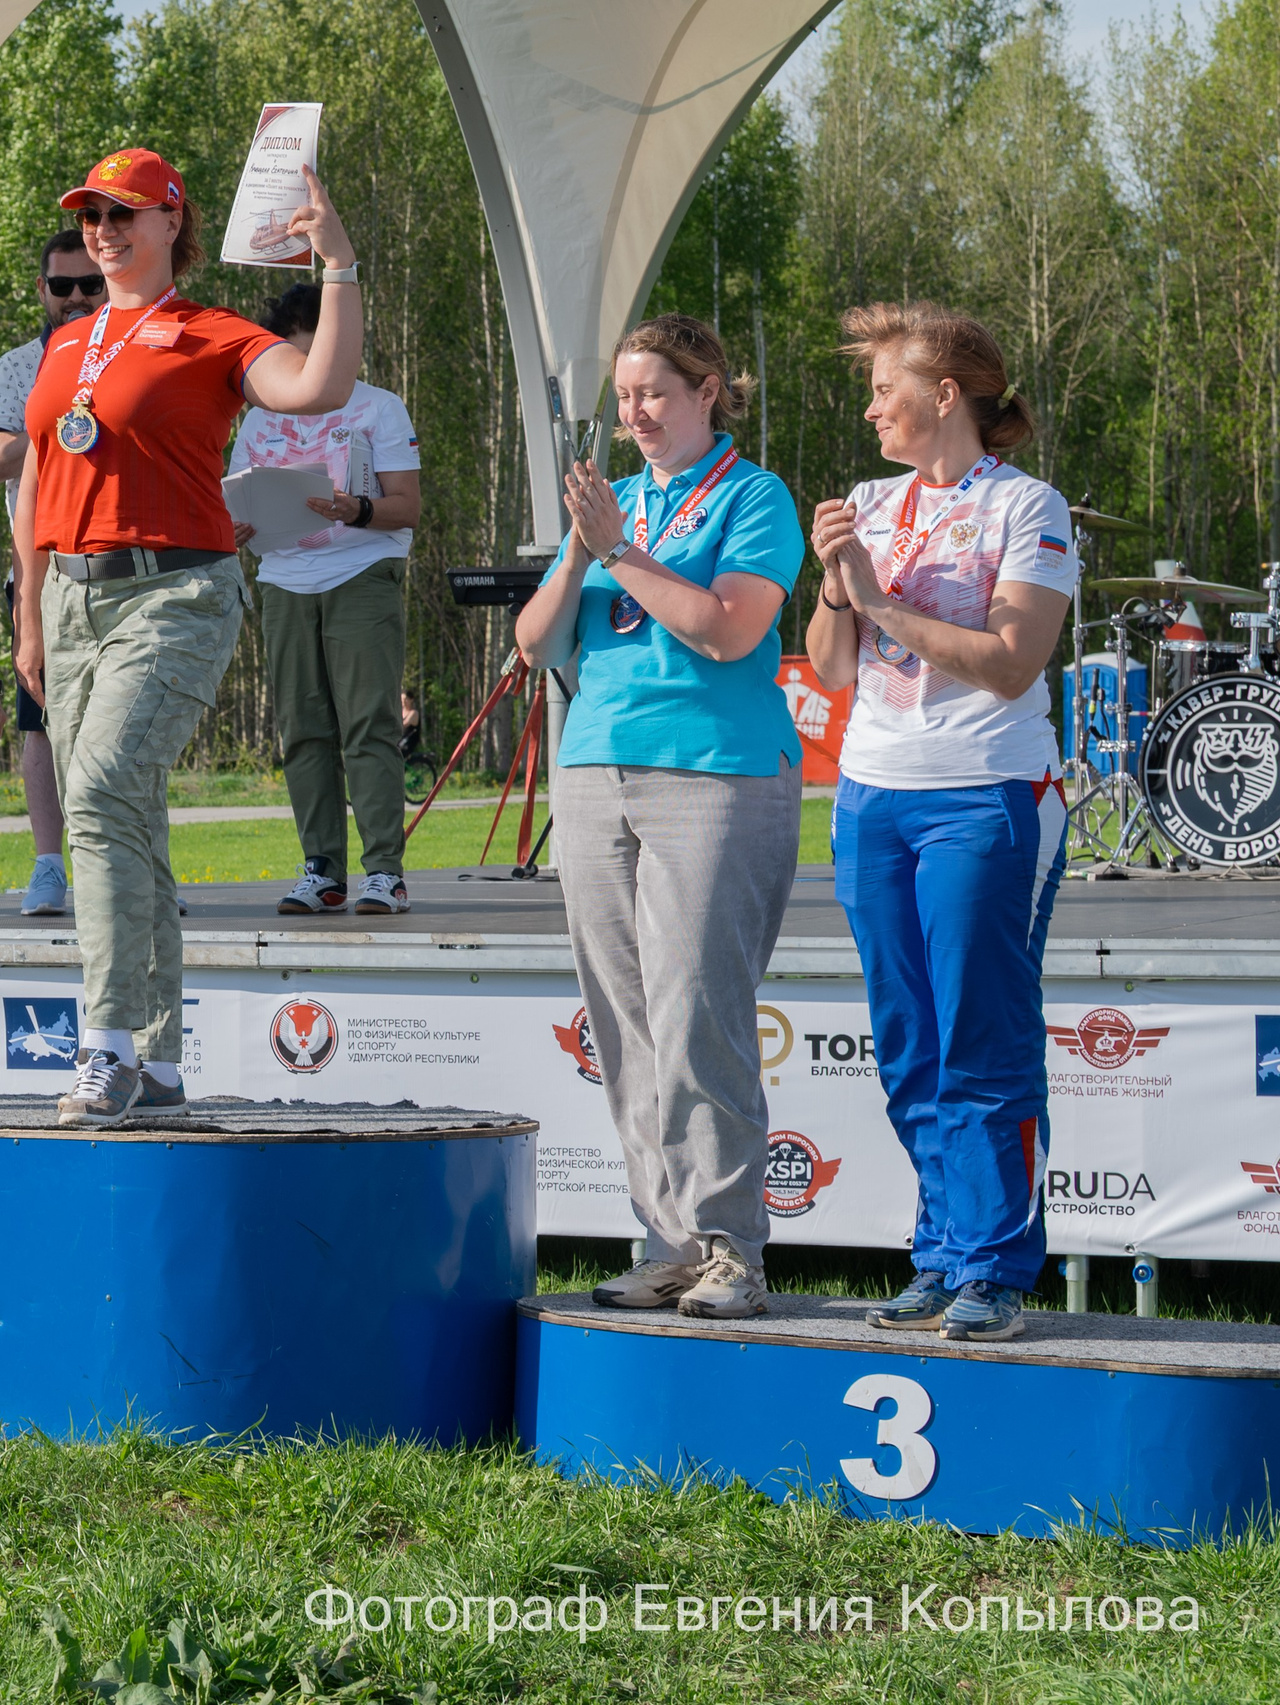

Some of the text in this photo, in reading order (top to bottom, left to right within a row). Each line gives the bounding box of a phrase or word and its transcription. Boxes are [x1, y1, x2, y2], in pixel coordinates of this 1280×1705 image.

[259, 136, 302, 152] ДИПЛОМ
[463, 576, 496, 586] YAMAHA
[1164, 814, 1215, 857] ДЕНЬ
[347, 1018, 427, 1029] МИНИСТРЕСТВО
[1078, 1009, 1134, 1032] БЛАГОТВОРИТЕЛЬНЫЙ
[1097, 1015, 1116, 1023] ФОНД
[347, 1030, 481, 1041] ПО ФИЗИЧЕСКОЙ КУЛЬТУРЕ
[347, 1041, 397, 1051] И СПОРТУ
[347, 1052, 480, 1064] УДМУРТСКОЙ РЕСПУБЛИКИ
[811, 1066, 880, 1077] БЛАГОУСТ
[1049, 1085, 1165, 1098] ФОНД ШТАБ ЖИЗНИ
[787, 1133, 819, 1161] ПИРОГОВО
[538, 1159, 626, 1170] ФИЗИЧЕСКОЙ КУЛ
[765, 1160, 812, 1180] XSPI
[537, 1170, 570, 1180] ПОРТУ
[588, 1184, 631, 1194] РЕСПУБ
[1048, 1170, 1157, 1202] RUDA
[769, 1195, 806, 1207] ИЖЕВСК
[787, 1205, 810, 1216] РОССИИ
[1044, 1202, 1136, 1216] УСТРОЙСТВО
[1243, 1223, 1280, 1235] ФОНД
[839, 1373, 936, 1500] 3
